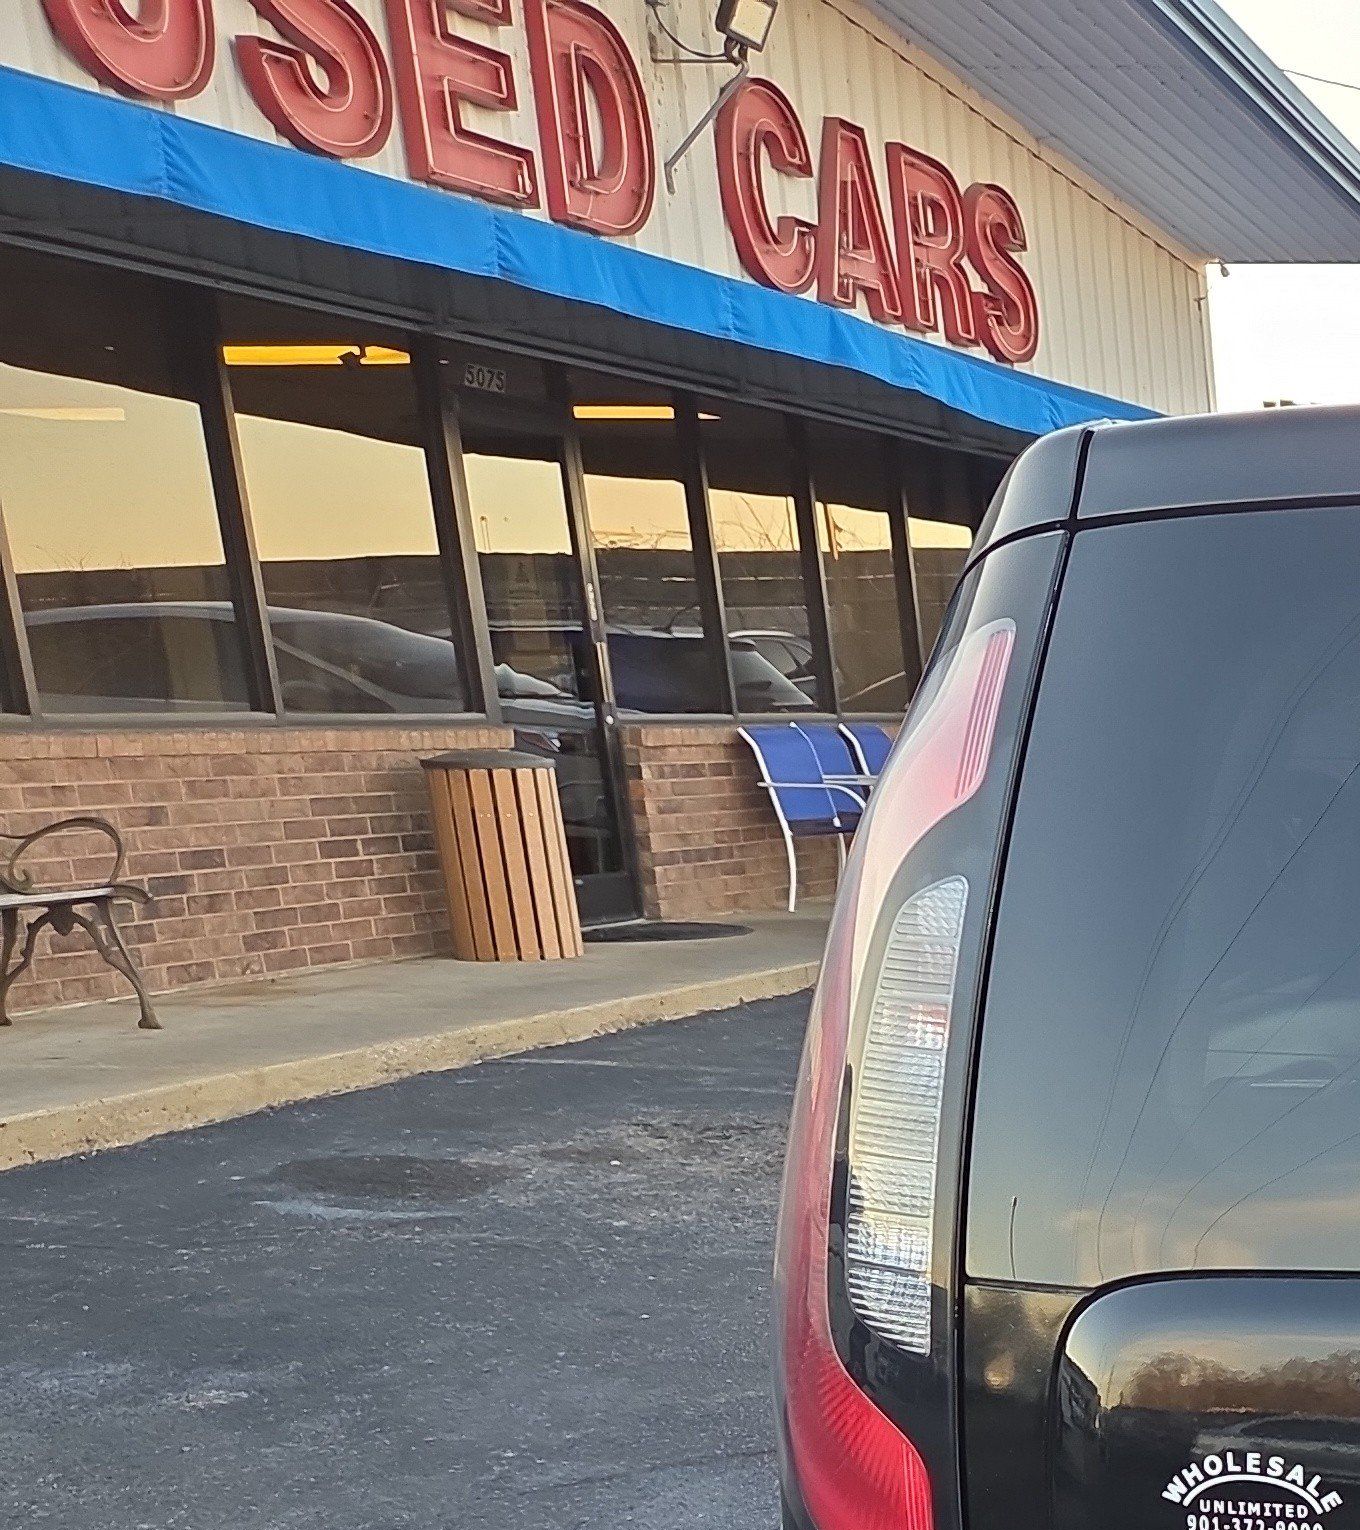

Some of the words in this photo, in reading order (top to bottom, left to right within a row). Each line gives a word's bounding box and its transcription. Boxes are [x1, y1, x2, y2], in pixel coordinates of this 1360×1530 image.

[715, 77, 1040, 363] CARS
[464, 364, 505, 392] 5075
[1161, 1451, 1344, 1515] WHOLESALE
[1199, 1499, 1309, 1519] UNLIMITED
